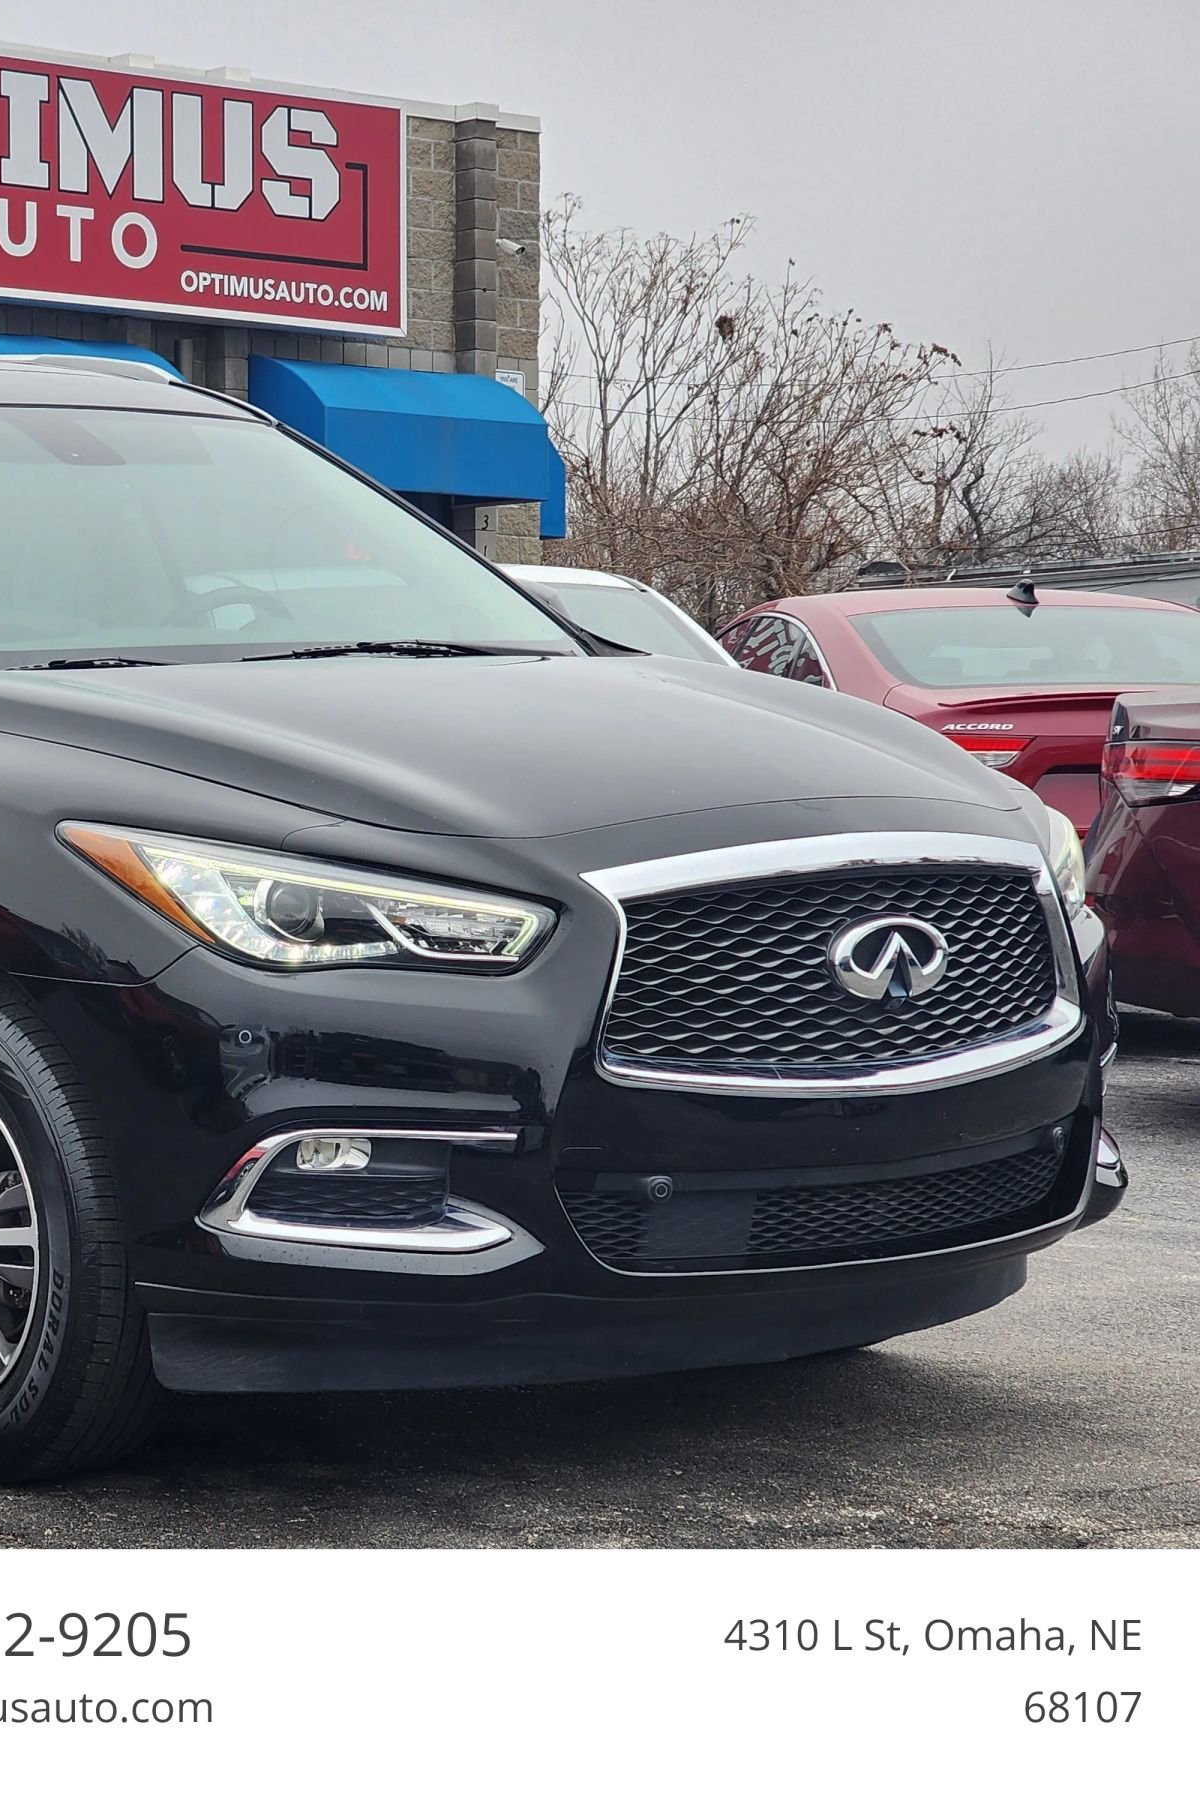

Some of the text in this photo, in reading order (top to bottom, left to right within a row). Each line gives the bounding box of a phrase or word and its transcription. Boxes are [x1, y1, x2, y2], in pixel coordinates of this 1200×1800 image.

[180, 270, 388, 312] OPTIMUSAUTO.COM
[940, 723, 1014, 731] ACCORD
[37, 1267, 65, 1373] DORAL
